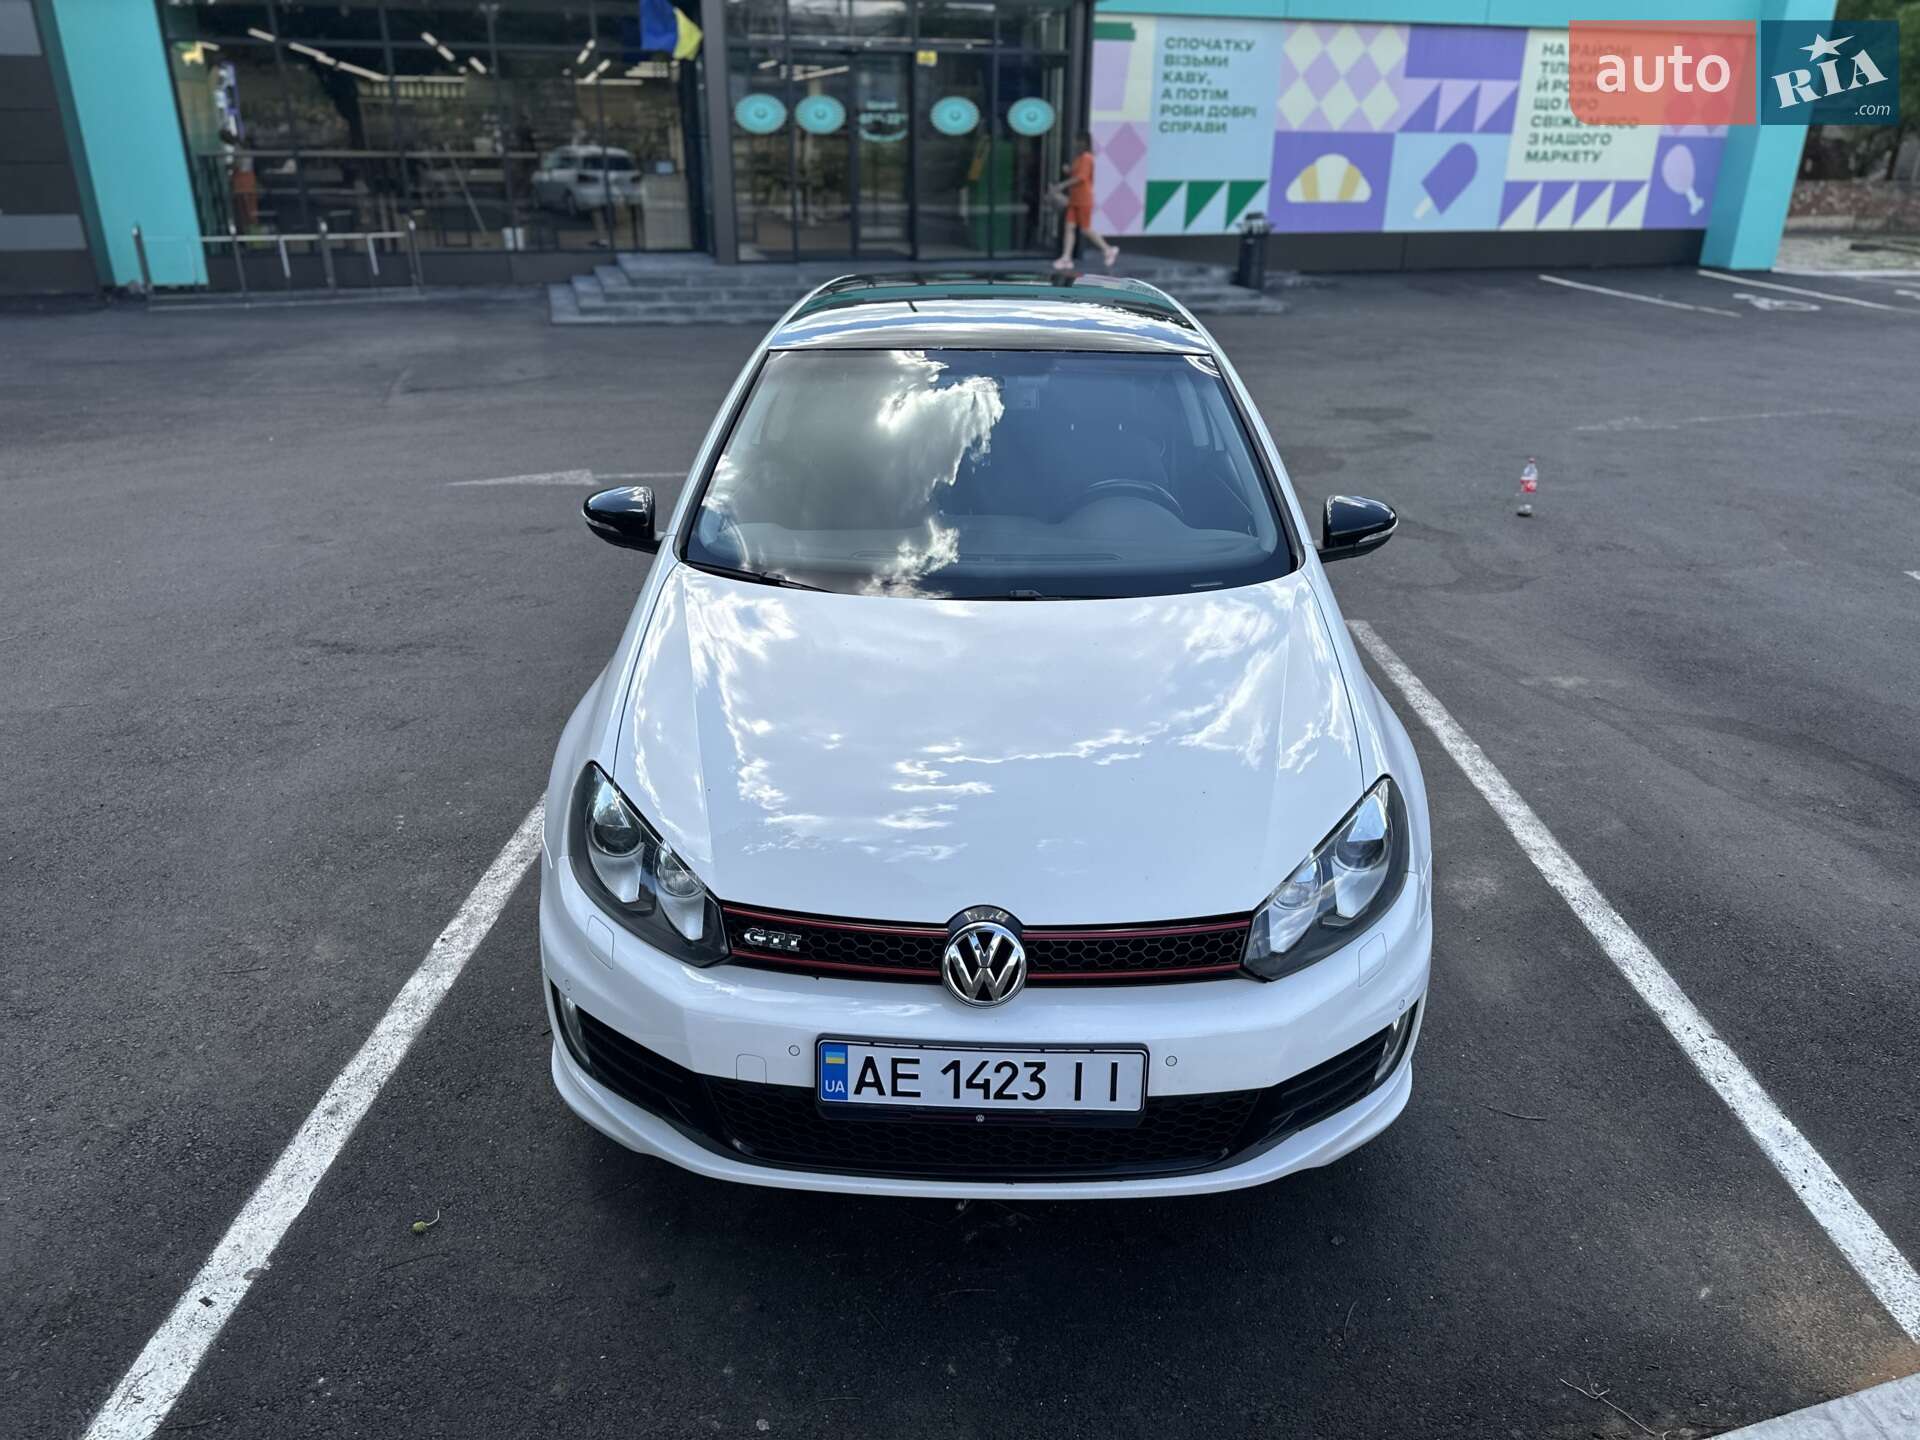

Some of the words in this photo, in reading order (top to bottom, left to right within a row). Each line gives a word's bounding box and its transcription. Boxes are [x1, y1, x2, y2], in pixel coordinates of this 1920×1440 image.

[1165, 37, 1255, 51] СПОЧАТКУ
[1542, 43, 1565, 55] НА
[1164, 54, 1229, 67] ВІЗЬМИ
[1162, 71, 1213, 85] КАВУ,
[1162, 88, 1172, 99] А
[1175, 88, 1228, 101] ПОТІМ
[1161, 103, 1205, 117] РОБИ
[1533, 98, 1561, 111] ЩО
[1159, 121, 1228, 133] СПРАВИ
[1527, 132, 1539, 145] З
[1542, 133, 1612, 146] НАШОГО
[1524, 150, 1602, 163] МАРКЕТУ
[743, 927, 802, 952] GTI
[853, 1055, 922, 1098] AE
[940, 1059, 1048, 1101] 1423
[825, 1079, 846, 1094] UA
